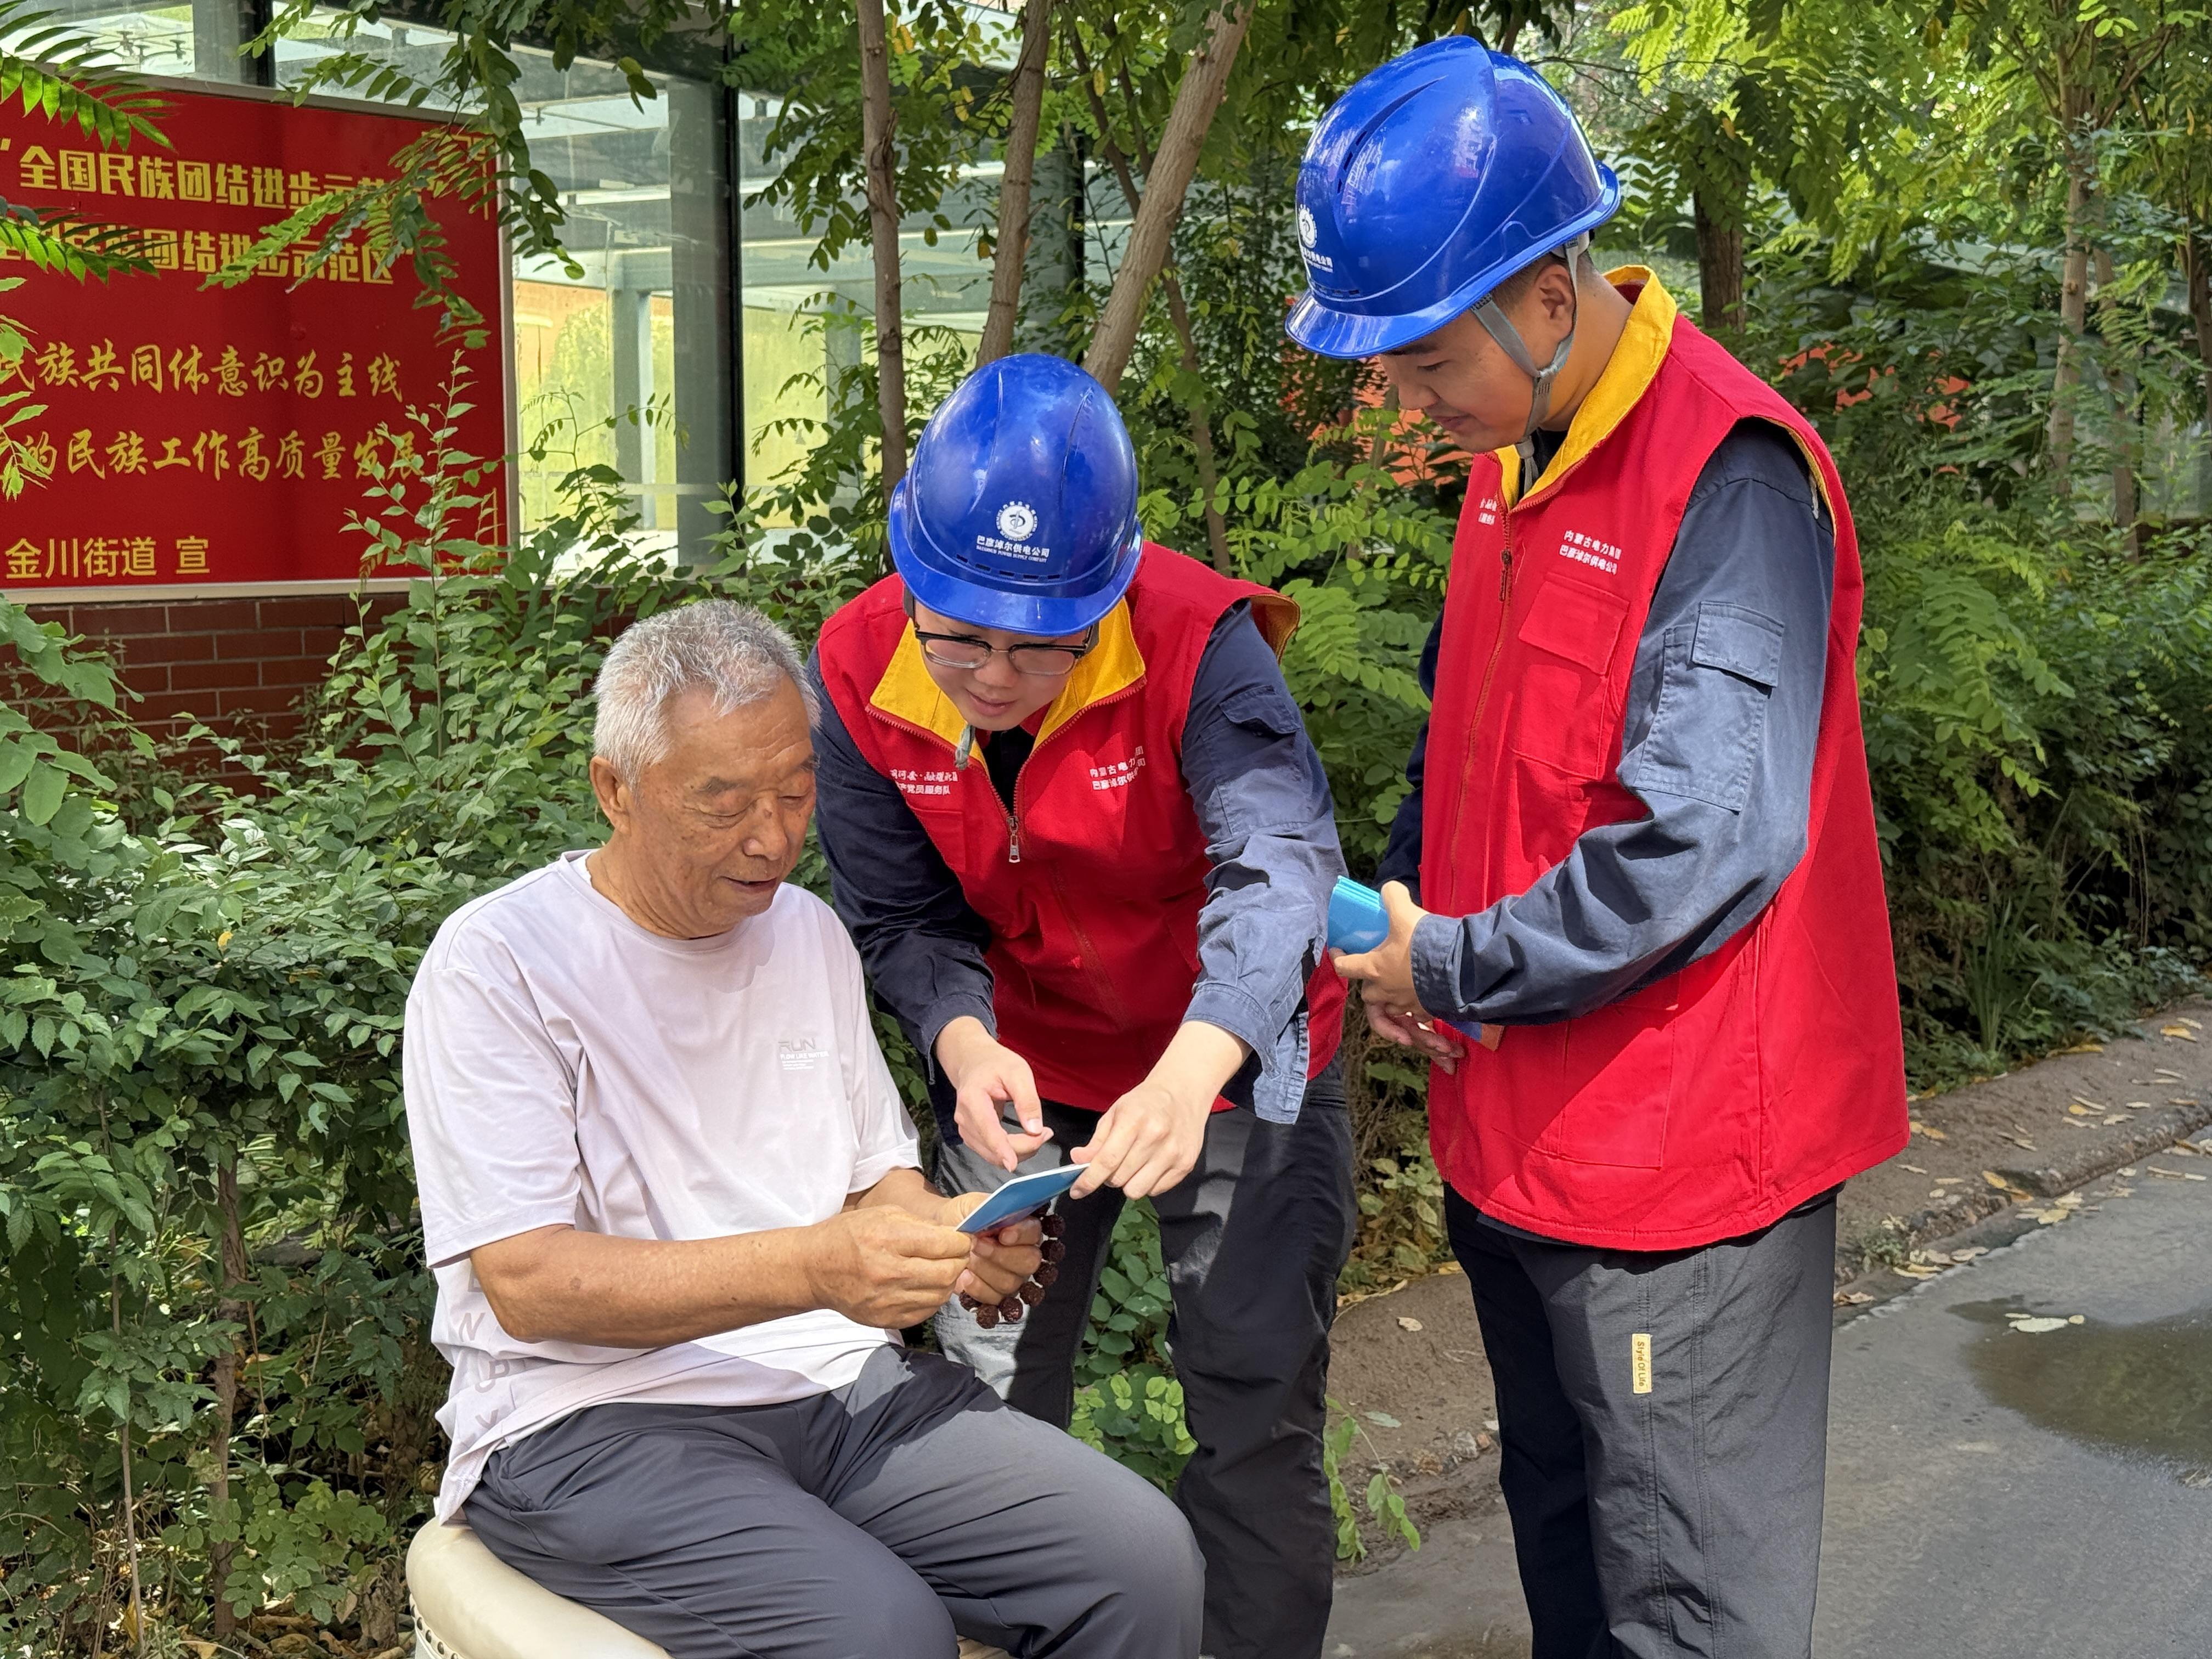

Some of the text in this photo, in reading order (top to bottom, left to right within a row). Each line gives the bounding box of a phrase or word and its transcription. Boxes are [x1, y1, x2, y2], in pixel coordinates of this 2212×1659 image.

[0, 426, 424, 482] 的民族工作高质量发展
[5, 535, 211, 579] 金川街道 宣
[977, 535, 1050, 557] 巴彦淖尔供电公司
[895, 780, 950, 795] 产党员服务队
[778, 1037, 816, 1052] RUN
